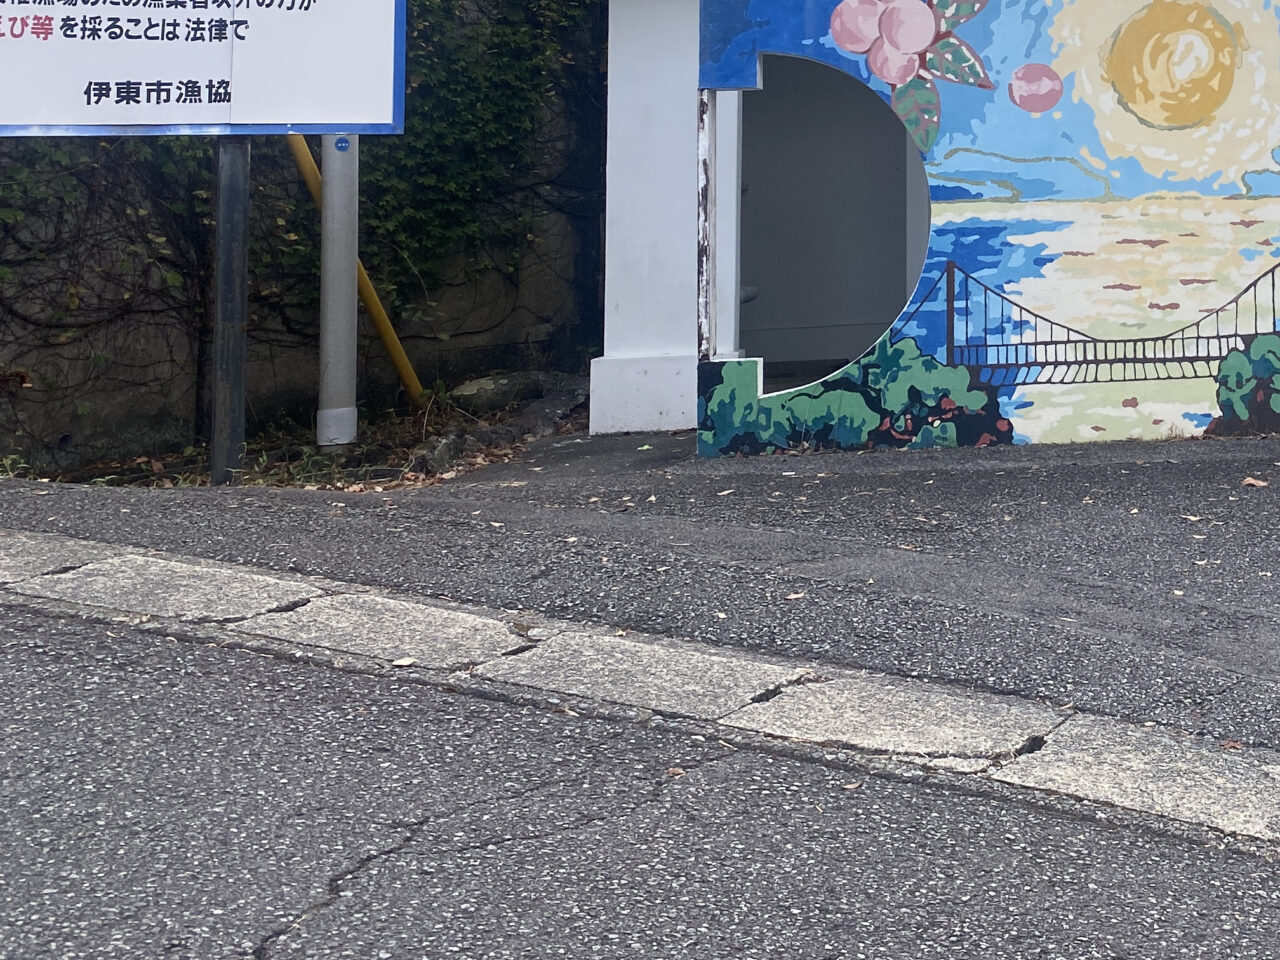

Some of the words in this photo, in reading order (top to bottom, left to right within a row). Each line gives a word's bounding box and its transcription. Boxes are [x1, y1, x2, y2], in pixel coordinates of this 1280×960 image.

[0, 15, 250, 42] び等を採ることは法律で
[84, 79, 232, 105] 伊東市漁協
